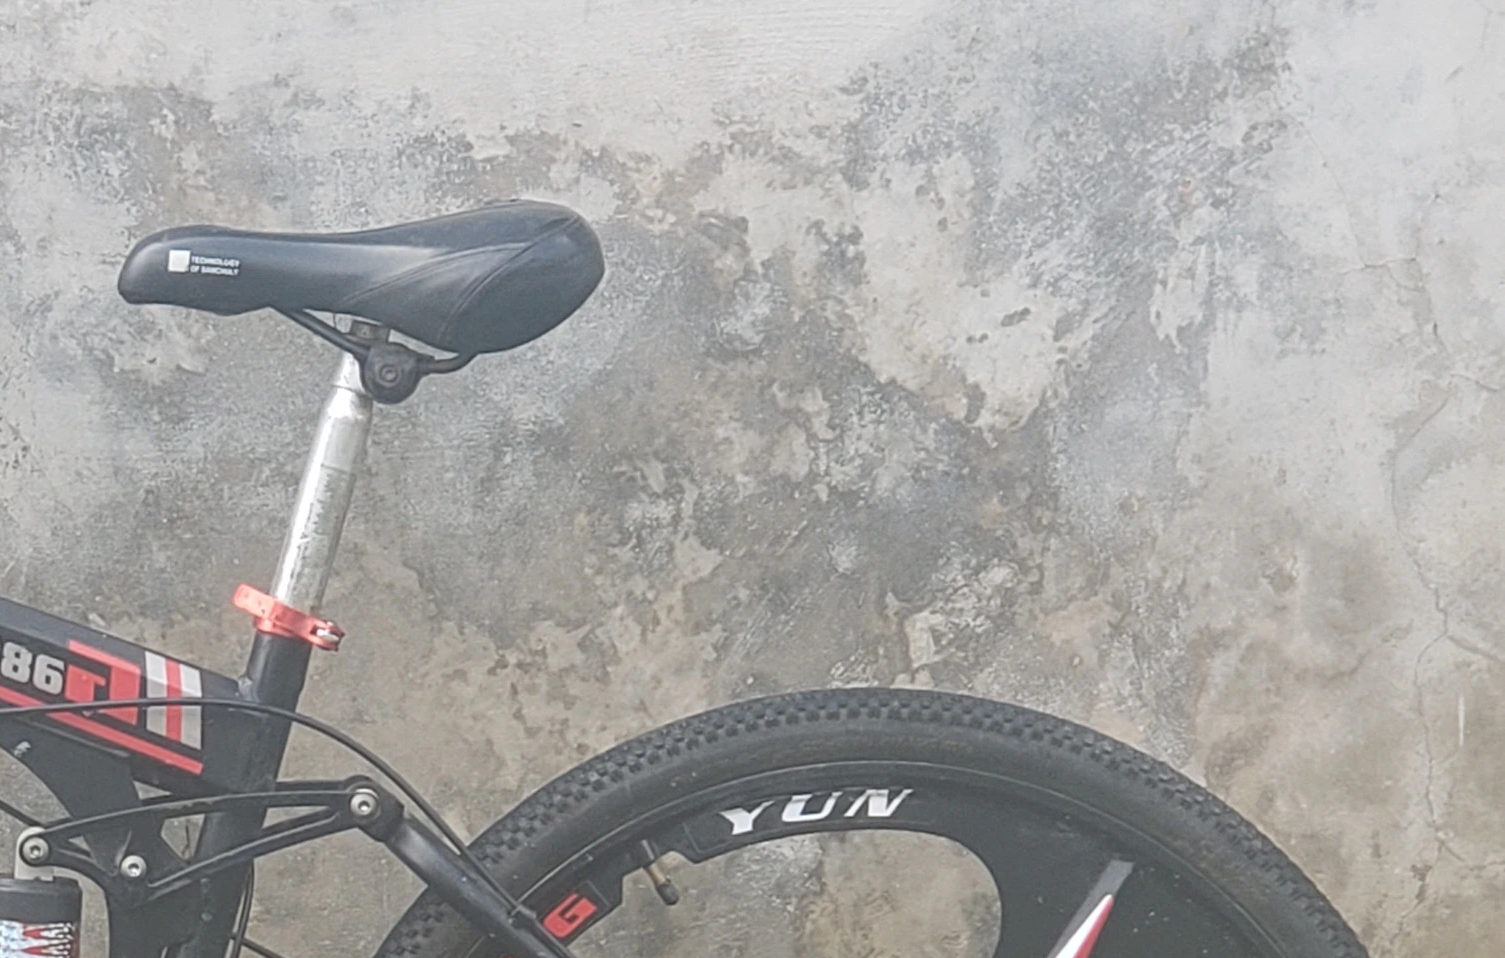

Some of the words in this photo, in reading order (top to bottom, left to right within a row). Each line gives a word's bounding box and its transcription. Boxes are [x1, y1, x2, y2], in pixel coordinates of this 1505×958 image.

[191, 255, 240, 267] TECHNOLOGY
[190, 265, 200, 273] OF
[720, 789, 914, 836] YUN
